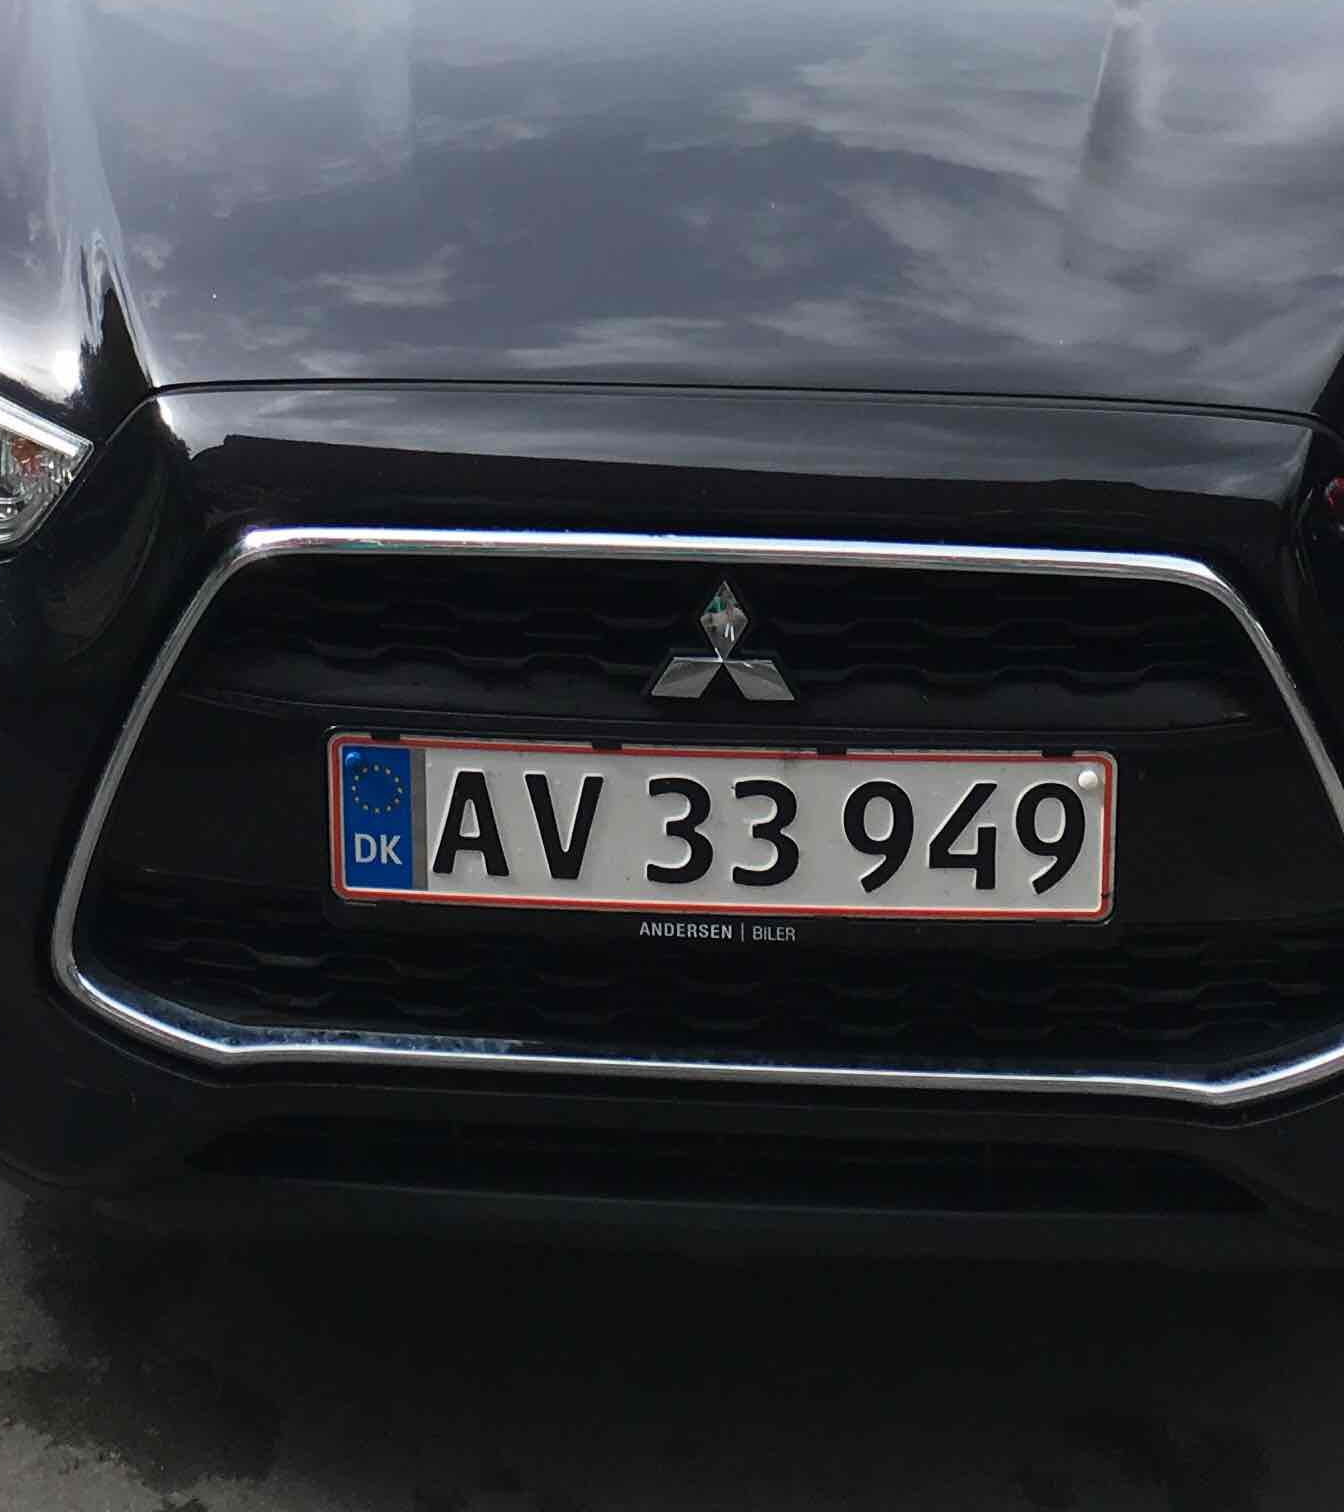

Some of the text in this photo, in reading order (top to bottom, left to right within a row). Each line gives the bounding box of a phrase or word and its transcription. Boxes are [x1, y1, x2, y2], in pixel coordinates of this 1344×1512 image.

[431, 770, 1087, 895] AV 33 949
[354, 833, 404, 866] DK
[639, 921, 796, 942] ANDERSEN BILER
